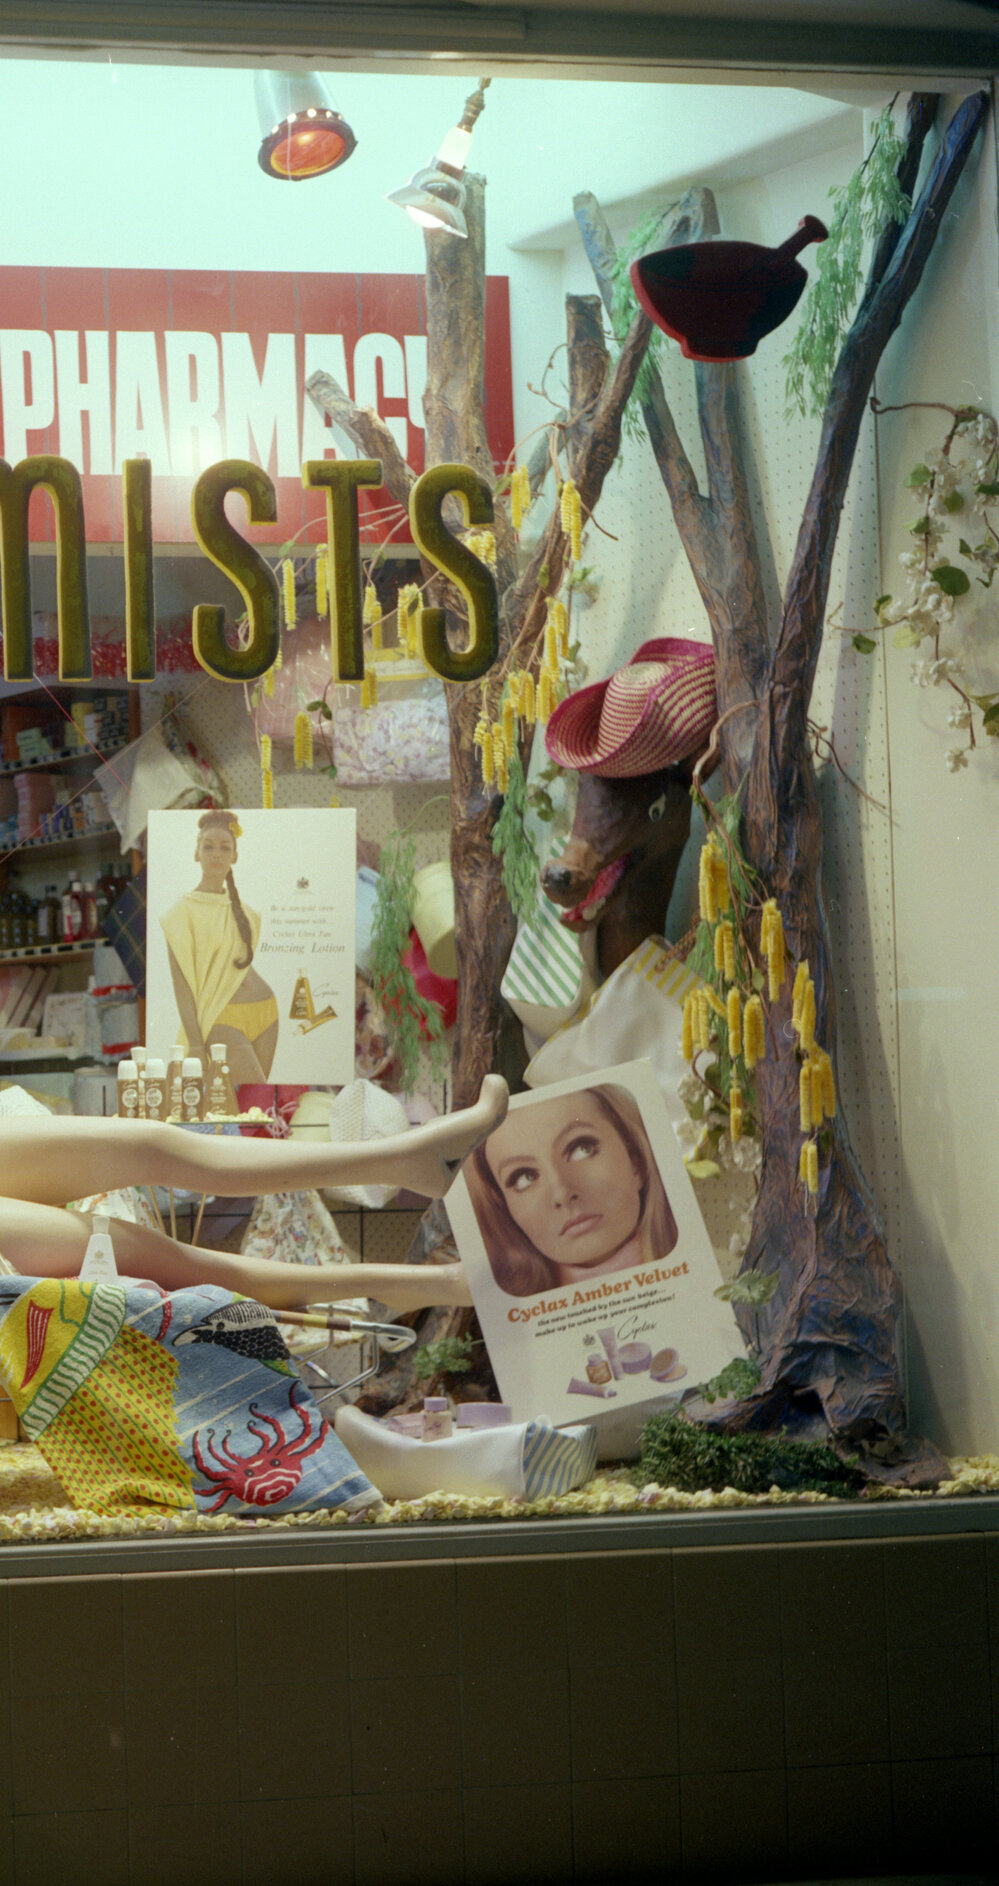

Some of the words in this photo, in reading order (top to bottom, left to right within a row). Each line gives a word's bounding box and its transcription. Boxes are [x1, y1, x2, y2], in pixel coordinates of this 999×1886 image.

[260, 942, 305, 955] Bronzing
[311, 942, 345, 953] Lotion
[507, 1297, 568, 1323] Cyclax
[571, 1279, 632, 1306] Amber
[633, 1261, 690, 1287] Velvet
[617, 1314, 657, 1340] Cyclax
